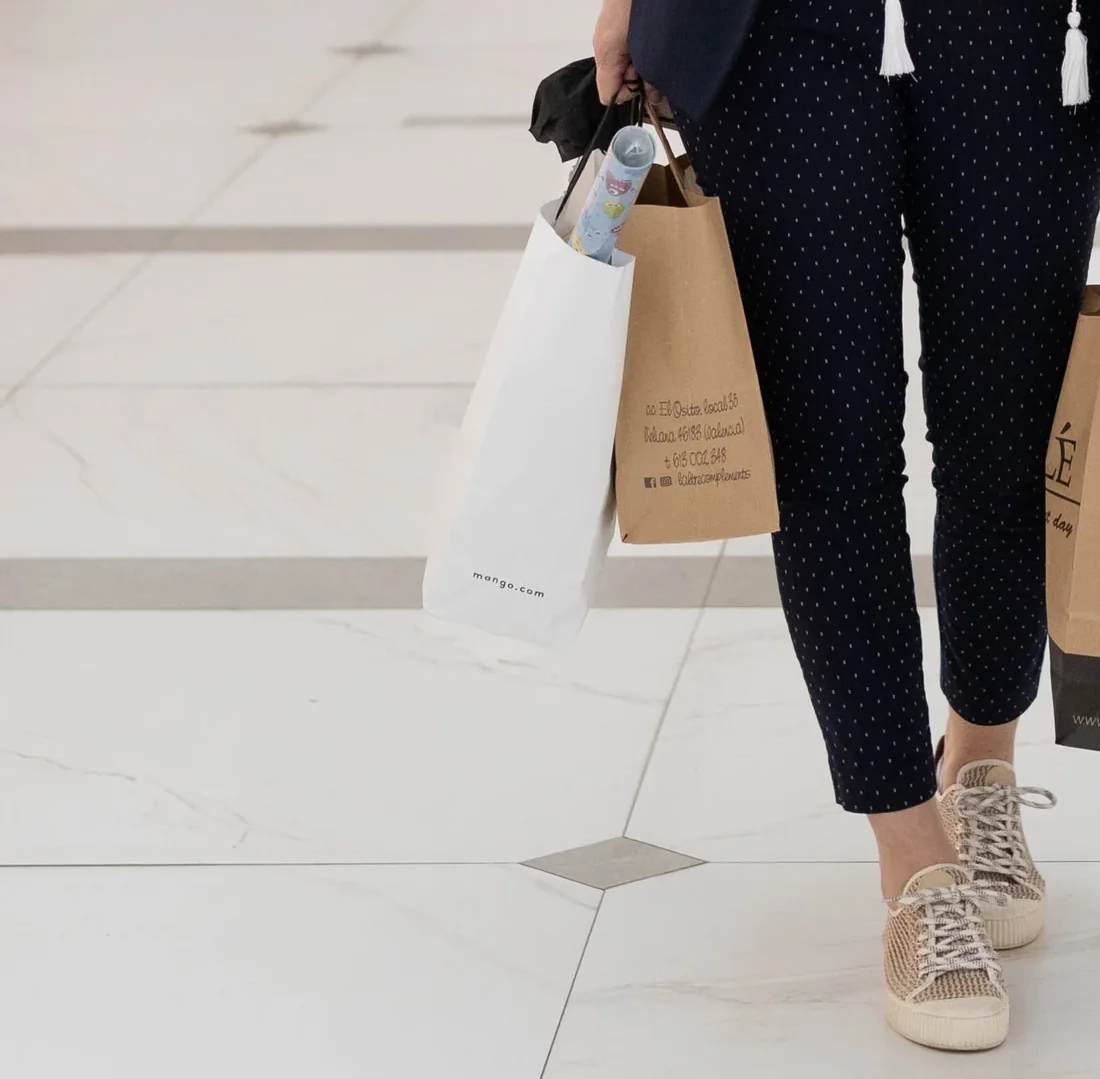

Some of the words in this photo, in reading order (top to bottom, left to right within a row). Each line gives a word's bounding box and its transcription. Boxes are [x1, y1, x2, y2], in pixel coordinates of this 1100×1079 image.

[659, 400, 672, 417] El
[703, 395, 728, 415] local
[672, 451, 688, 468] 613
[690, 449, 710, 466] 002
[710, 446, 727, 465] 348
[1052, 513, 1074, 538] day
[472, 572, 545, 598] mango.com
